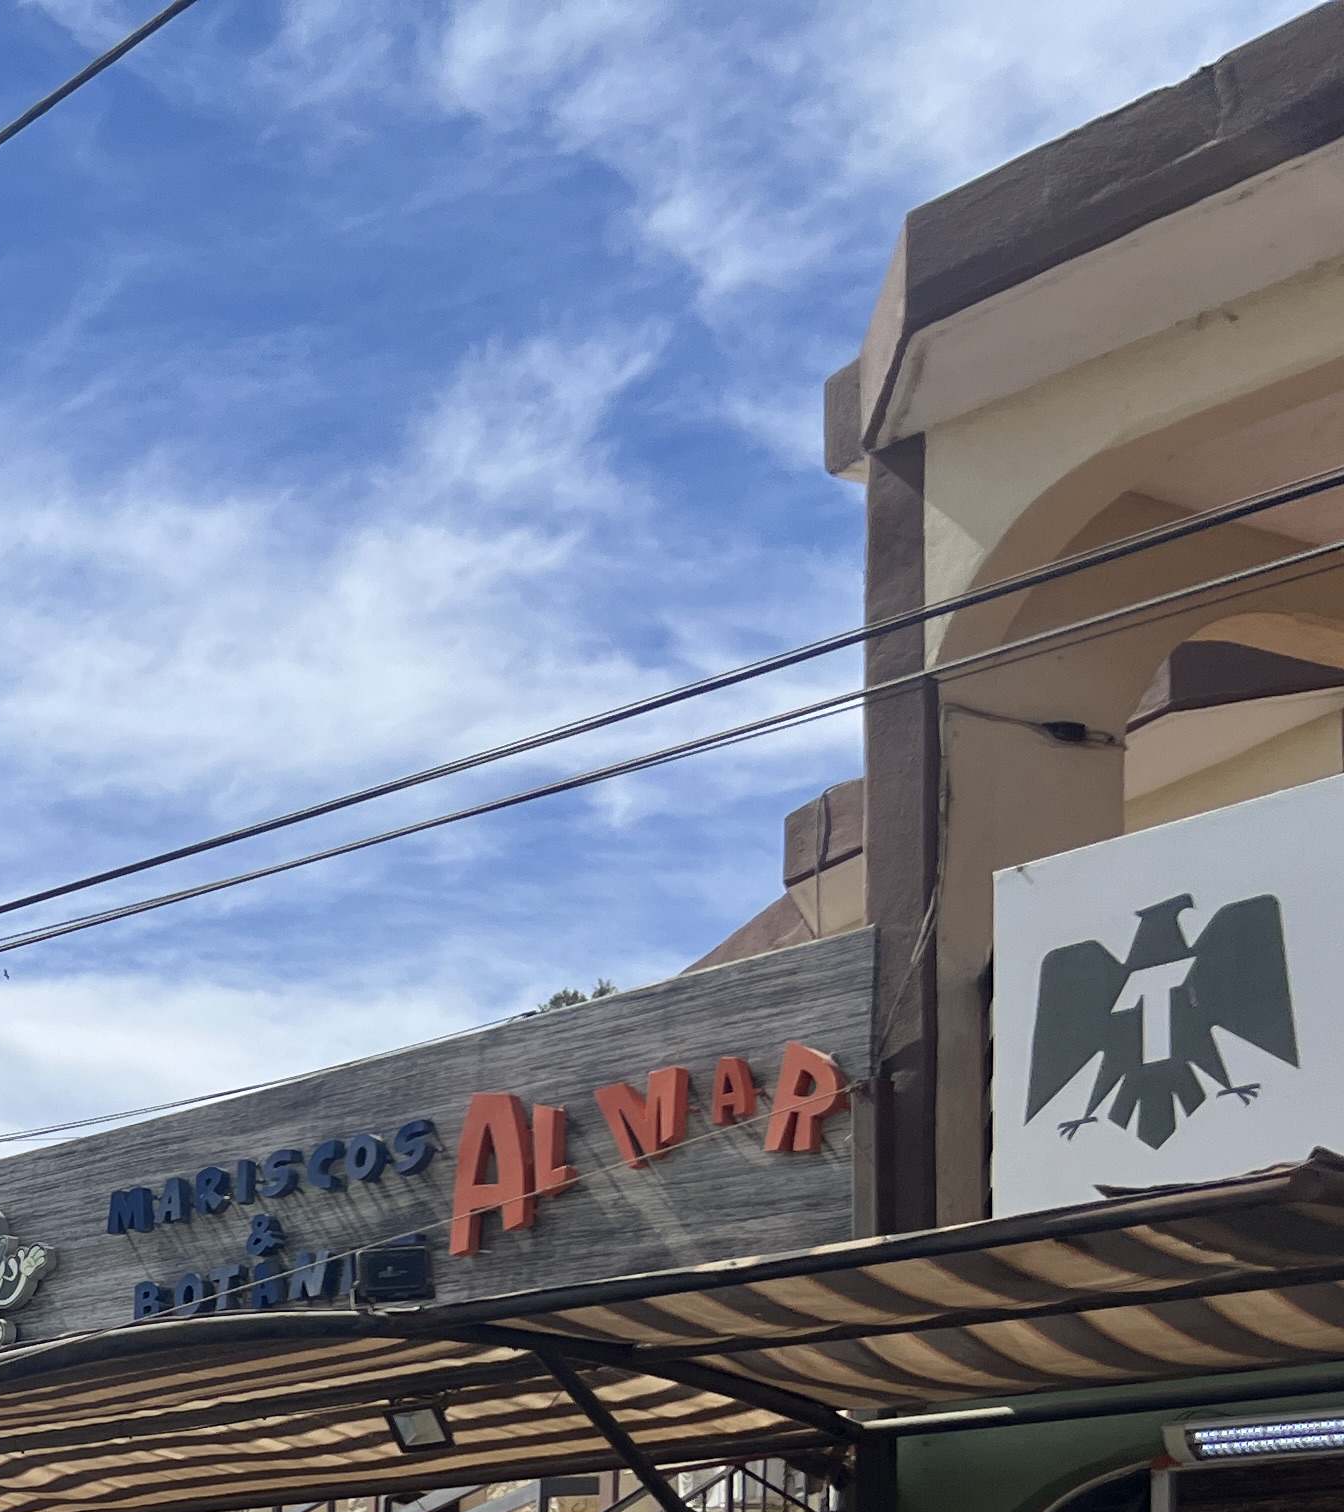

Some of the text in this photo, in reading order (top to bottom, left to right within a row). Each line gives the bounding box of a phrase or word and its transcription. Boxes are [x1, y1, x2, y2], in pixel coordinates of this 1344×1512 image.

[108, 1119, 435, 1235] MARISCOS
[449, 1041, 848, 1258] AL MAR
[133, 1233, 425, 1320] BOTAN
[247, 1214, 285, 1254] &
